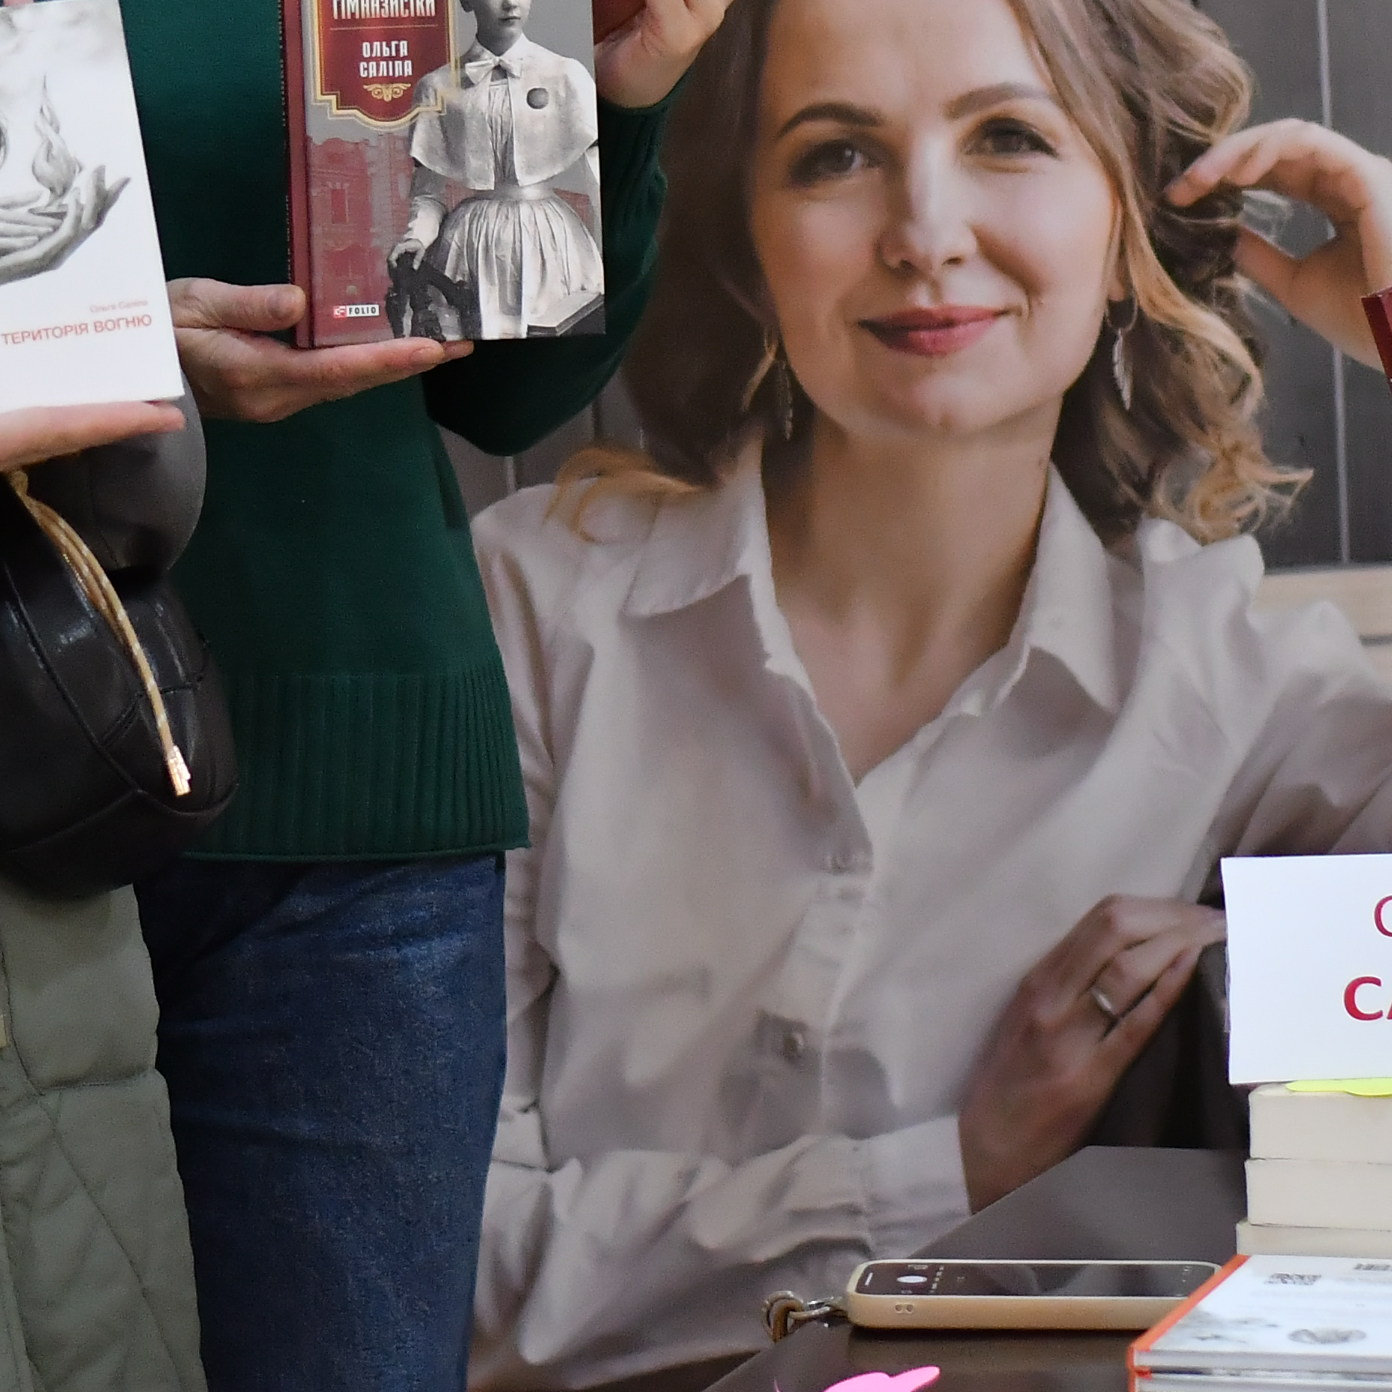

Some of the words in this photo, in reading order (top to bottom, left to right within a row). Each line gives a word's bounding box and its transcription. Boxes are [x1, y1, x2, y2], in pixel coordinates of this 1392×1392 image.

[361, 39, 409, 59] ОЛЬГА
[359, 59, 414, 79] САЛІПА
[348, 306, 378, 316] FOLIO
[0, 322, 89, 346] ТЕРИТОРІЯ
[93, 313, 153, 334] ВОГНЮ
